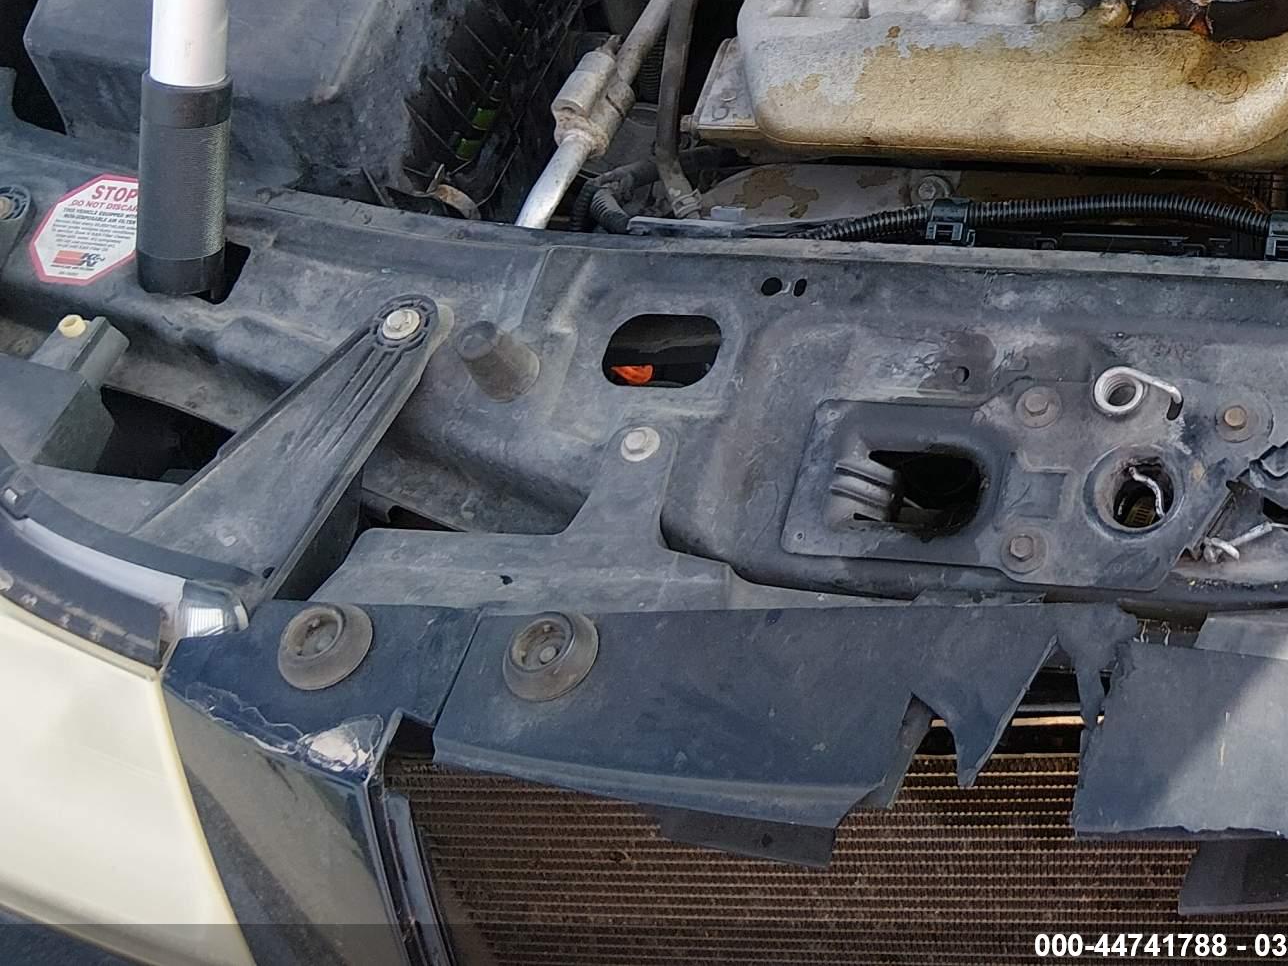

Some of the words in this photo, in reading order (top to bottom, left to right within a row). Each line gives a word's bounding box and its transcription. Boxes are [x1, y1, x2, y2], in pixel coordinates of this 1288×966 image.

[91, 184, 138, 203] STOP
[71, 199, 84, 207] DO
[85, 200, 106, 209] NOT
